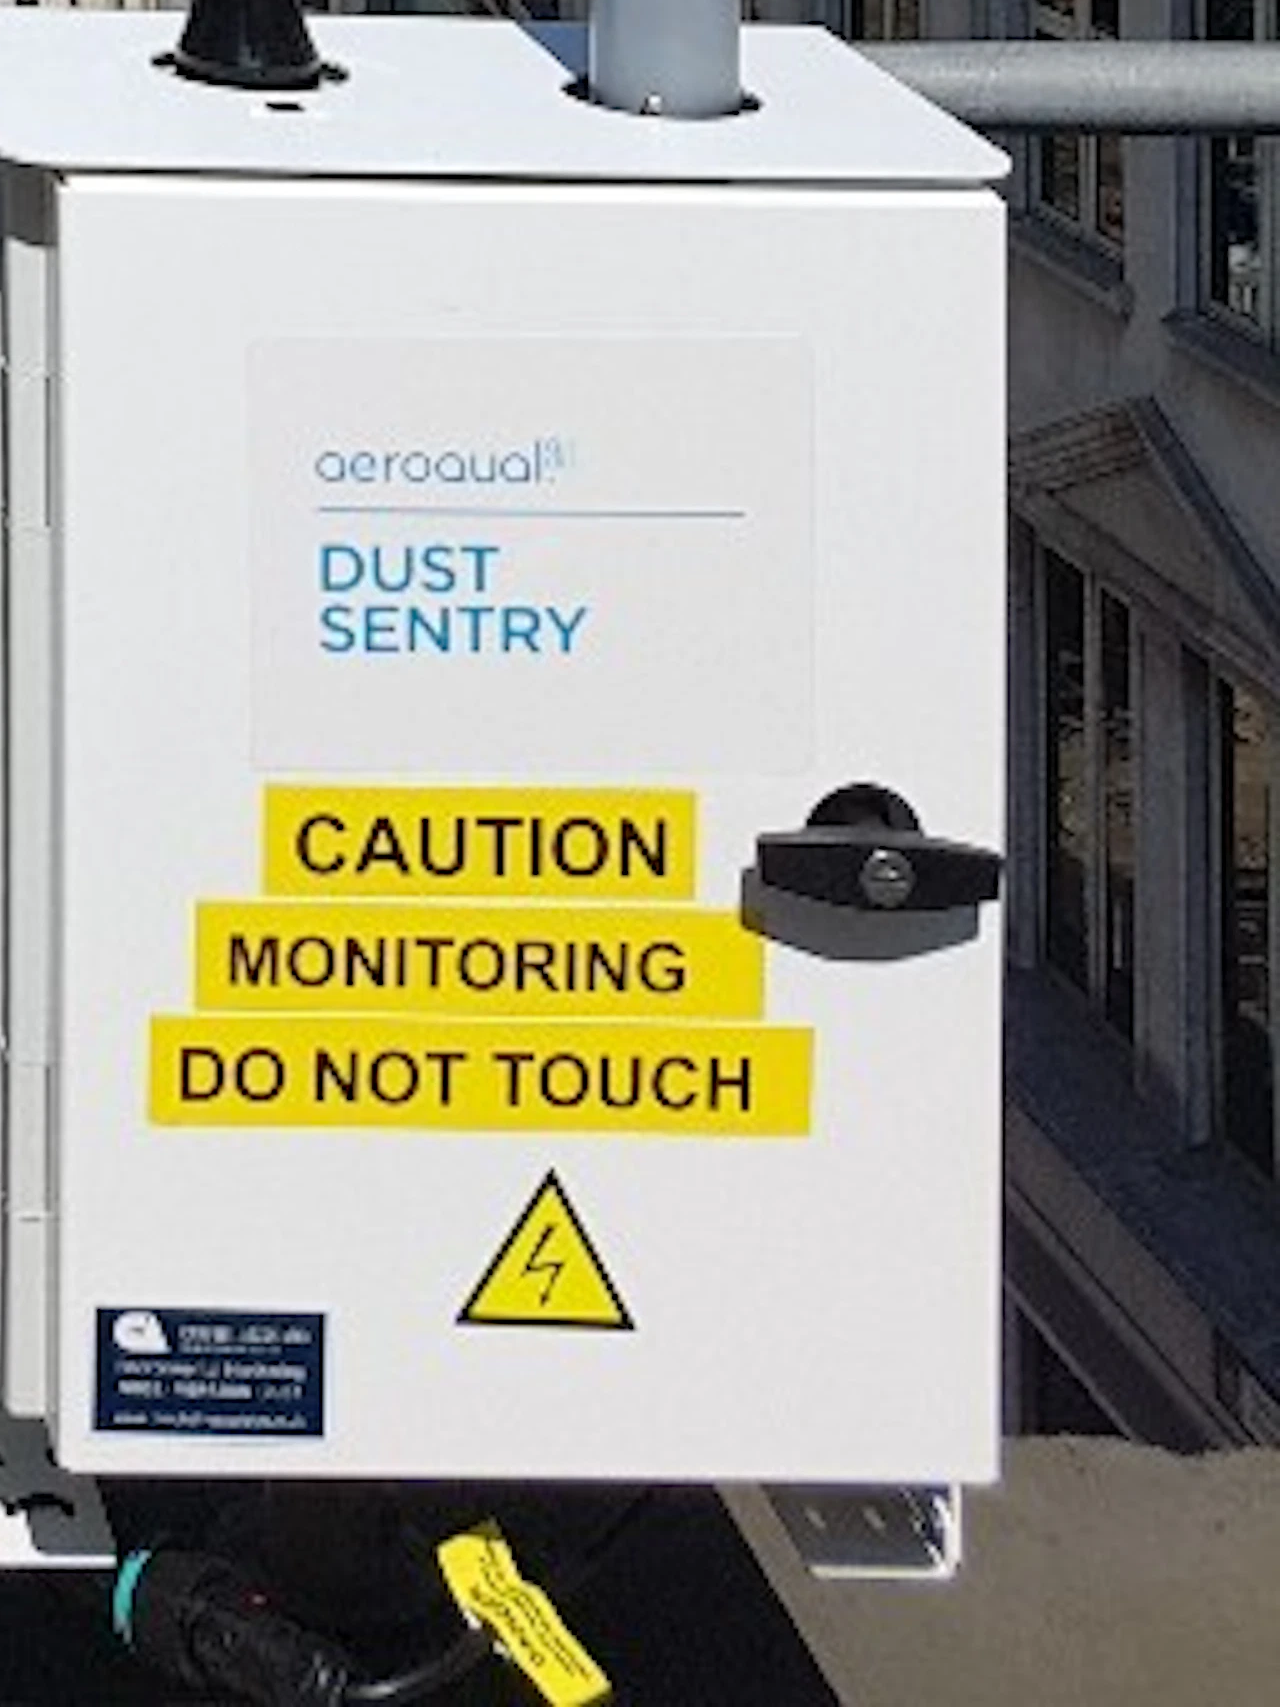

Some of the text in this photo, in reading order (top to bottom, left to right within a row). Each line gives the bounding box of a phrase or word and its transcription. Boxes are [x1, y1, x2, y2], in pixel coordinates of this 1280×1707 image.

[320, 545, 500, 594] DUST
[320, 604, 586, 653] SENTRY
[295, 814, 668, 879] CAUTION
[228, 934, 687, 994] MONITORING
[179, 1047, 752, 1112] DO NOT TOUCH
